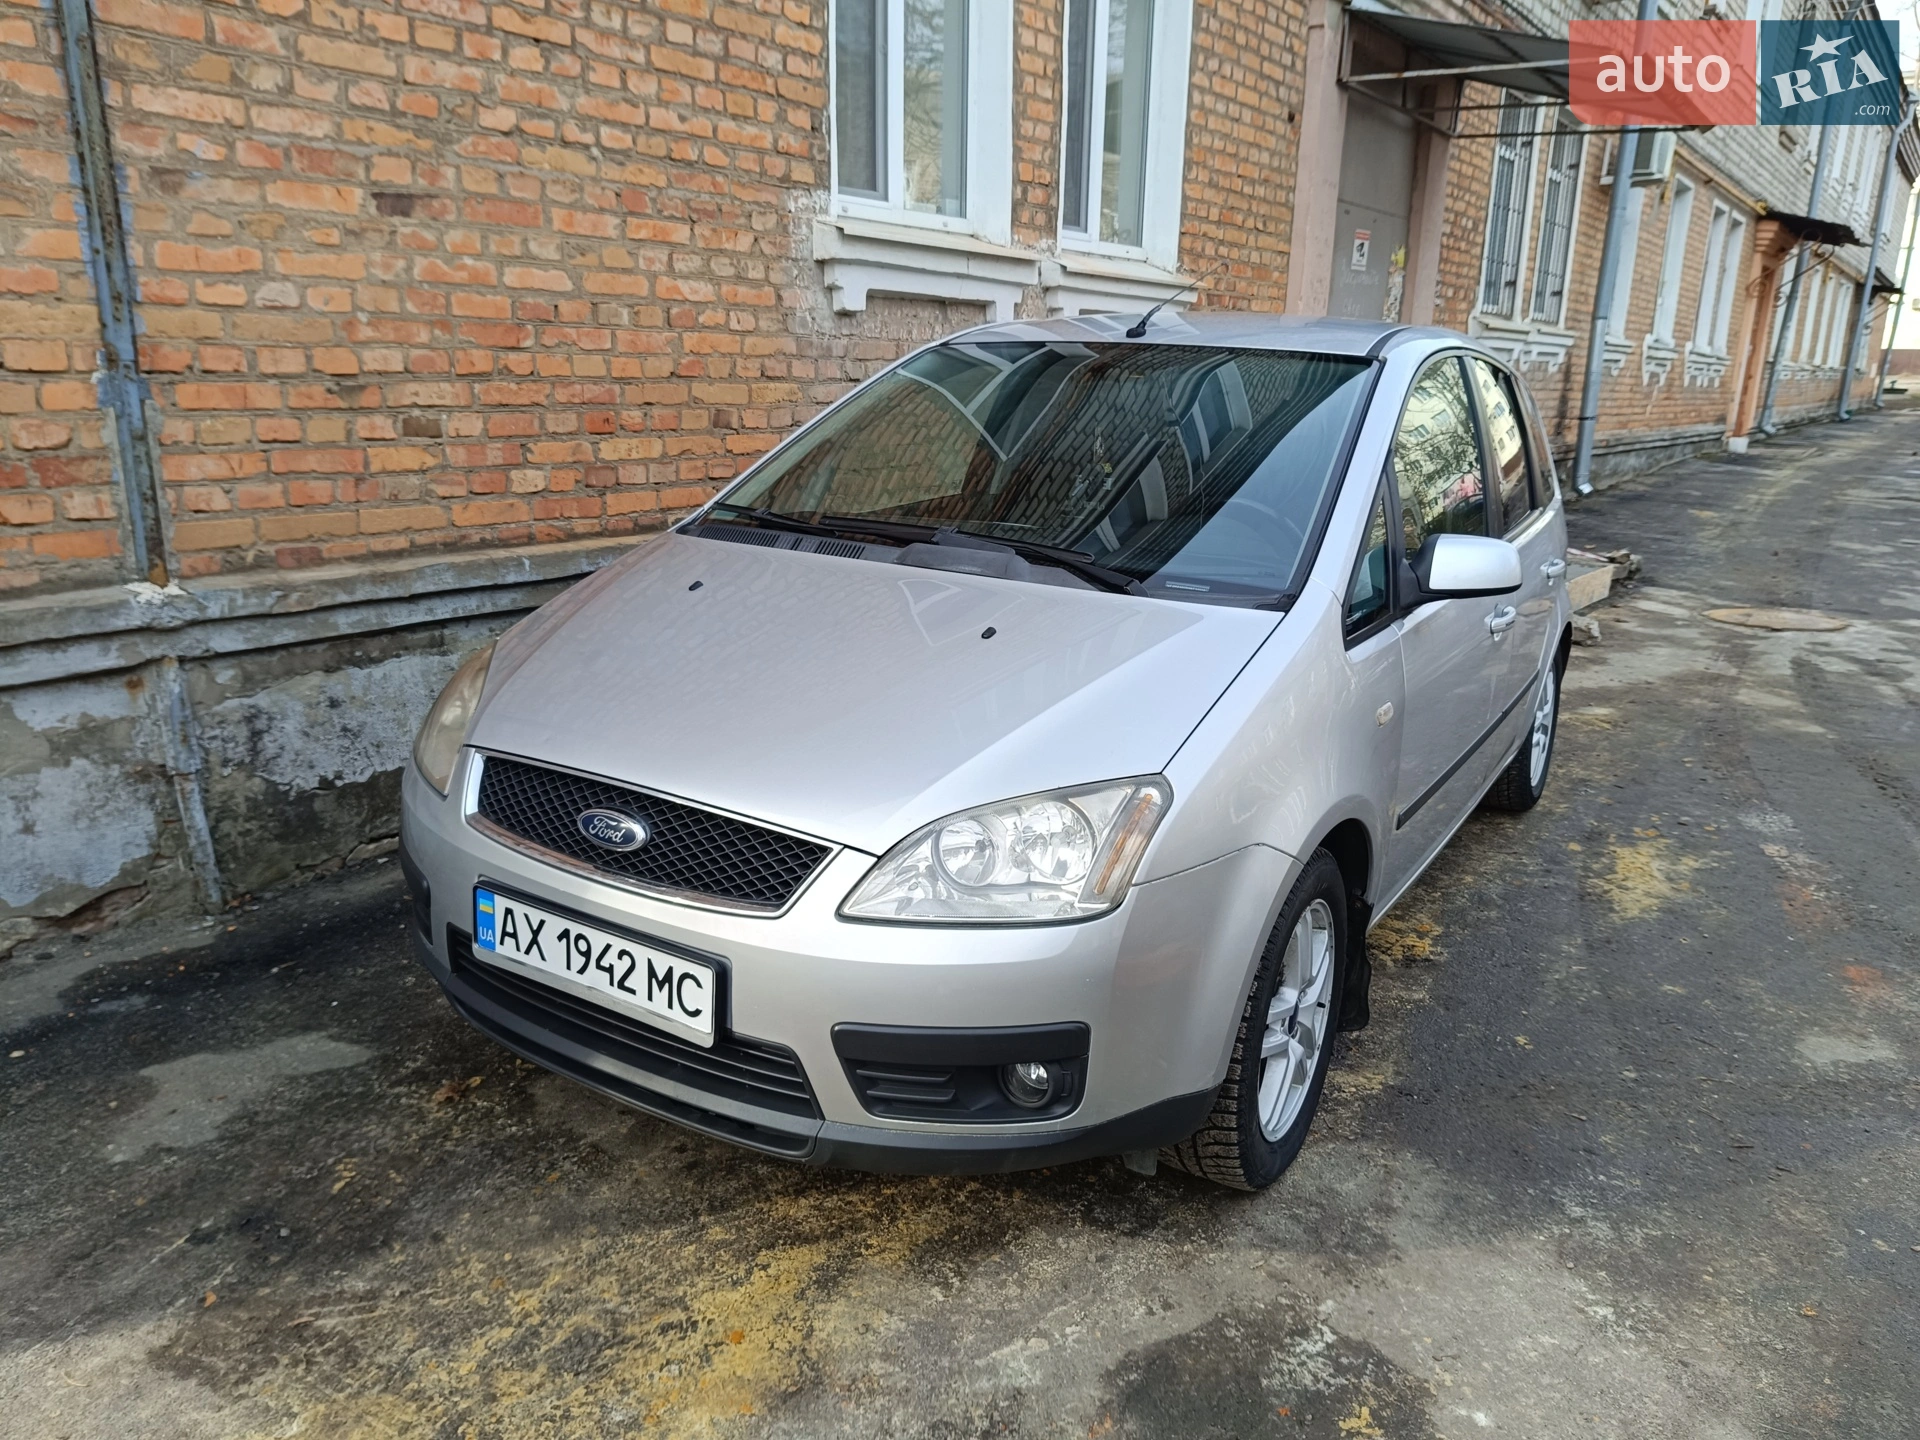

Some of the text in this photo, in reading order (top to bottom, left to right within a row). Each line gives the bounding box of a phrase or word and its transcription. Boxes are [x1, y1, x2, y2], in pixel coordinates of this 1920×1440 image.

[588, 816, 626, 843] Ford
[479, 926, 495, 943] UA
[499, 906, 704, 1018] AX 1942 MC
